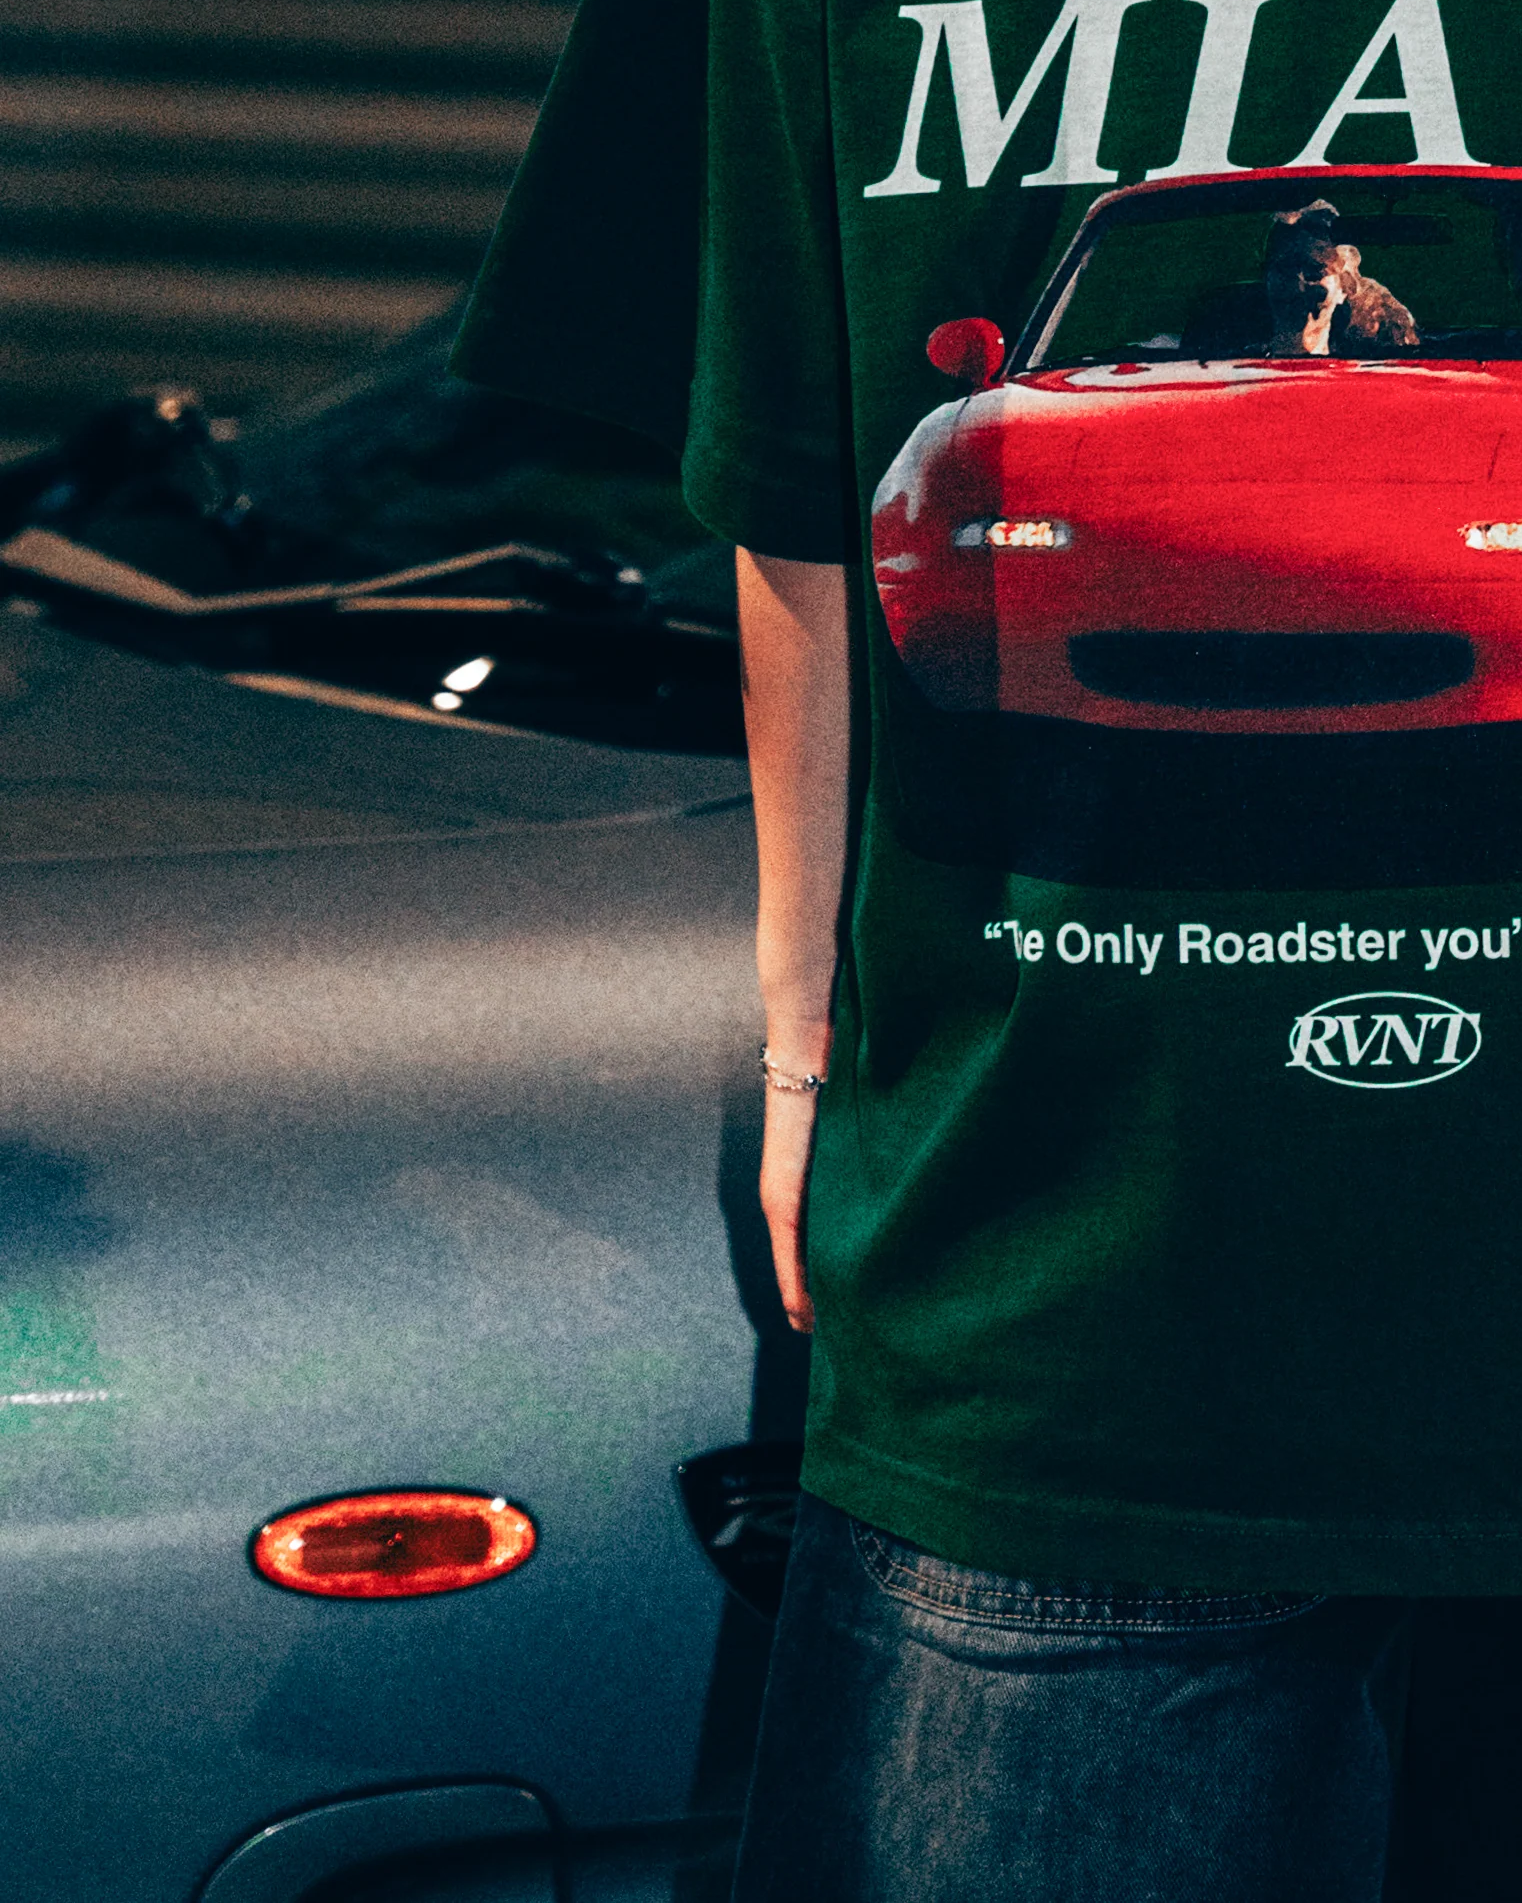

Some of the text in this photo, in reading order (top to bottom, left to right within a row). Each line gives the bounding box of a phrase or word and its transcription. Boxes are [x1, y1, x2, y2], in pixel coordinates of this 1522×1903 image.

[1056, 922, 1164, 975] Only
[1178, 922, 1406, 964] Roadster
[1284, 1012, 1482, 1068] RVNT
